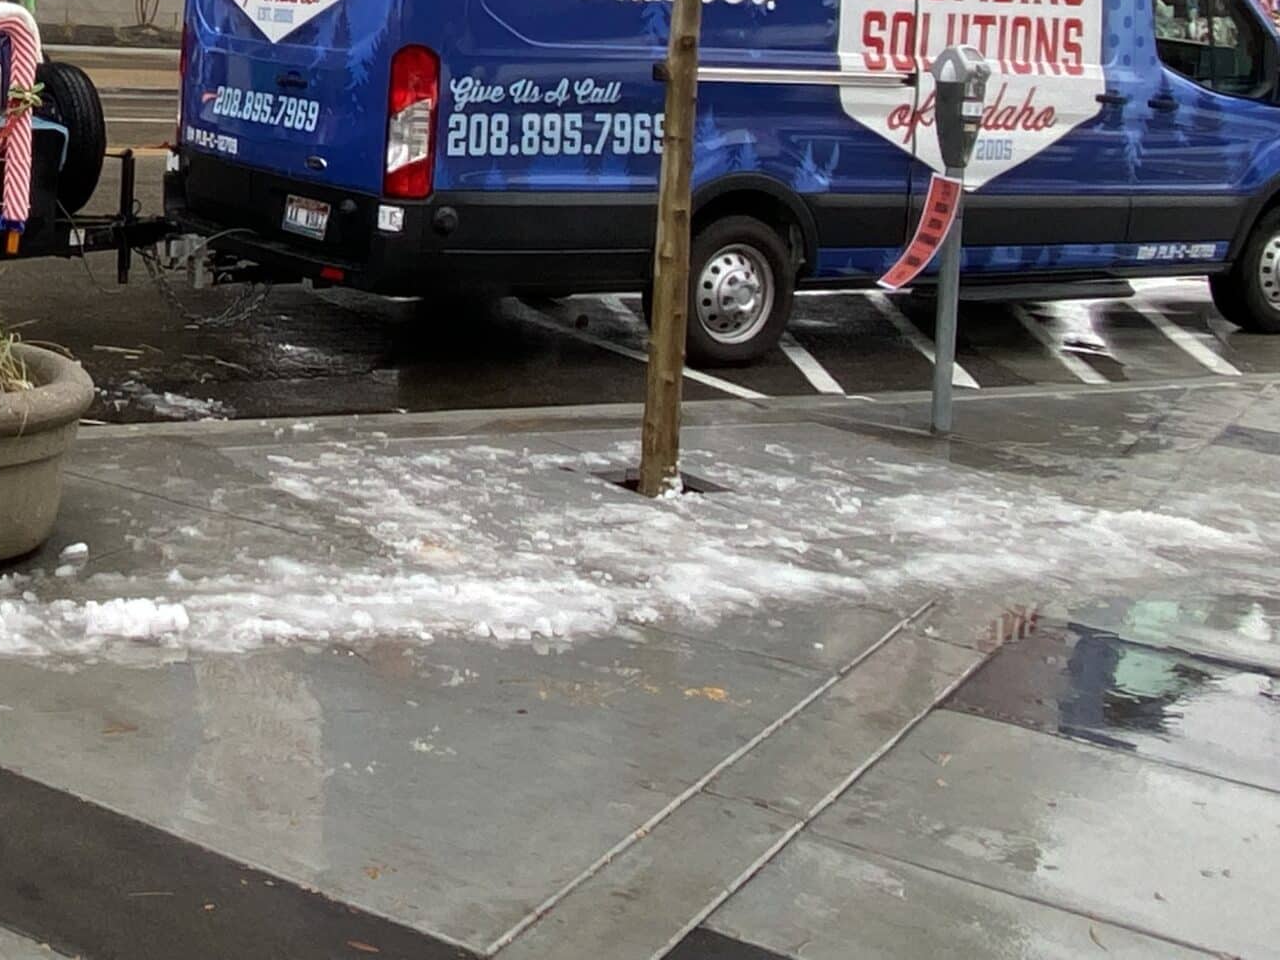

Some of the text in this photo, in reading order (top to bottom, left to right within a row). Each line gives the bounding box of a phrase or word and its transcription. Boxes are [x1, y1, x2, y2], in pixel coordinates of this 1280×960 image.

[862, 11, 1084, 76] SOLUTIONS
[213, 85, 319, 133] 208.895.7969
[450, 76, 621, 112] Give Us A Call
[887, 82, 1057, 144] of daho
[975, 139, 1013, 161] 2005
